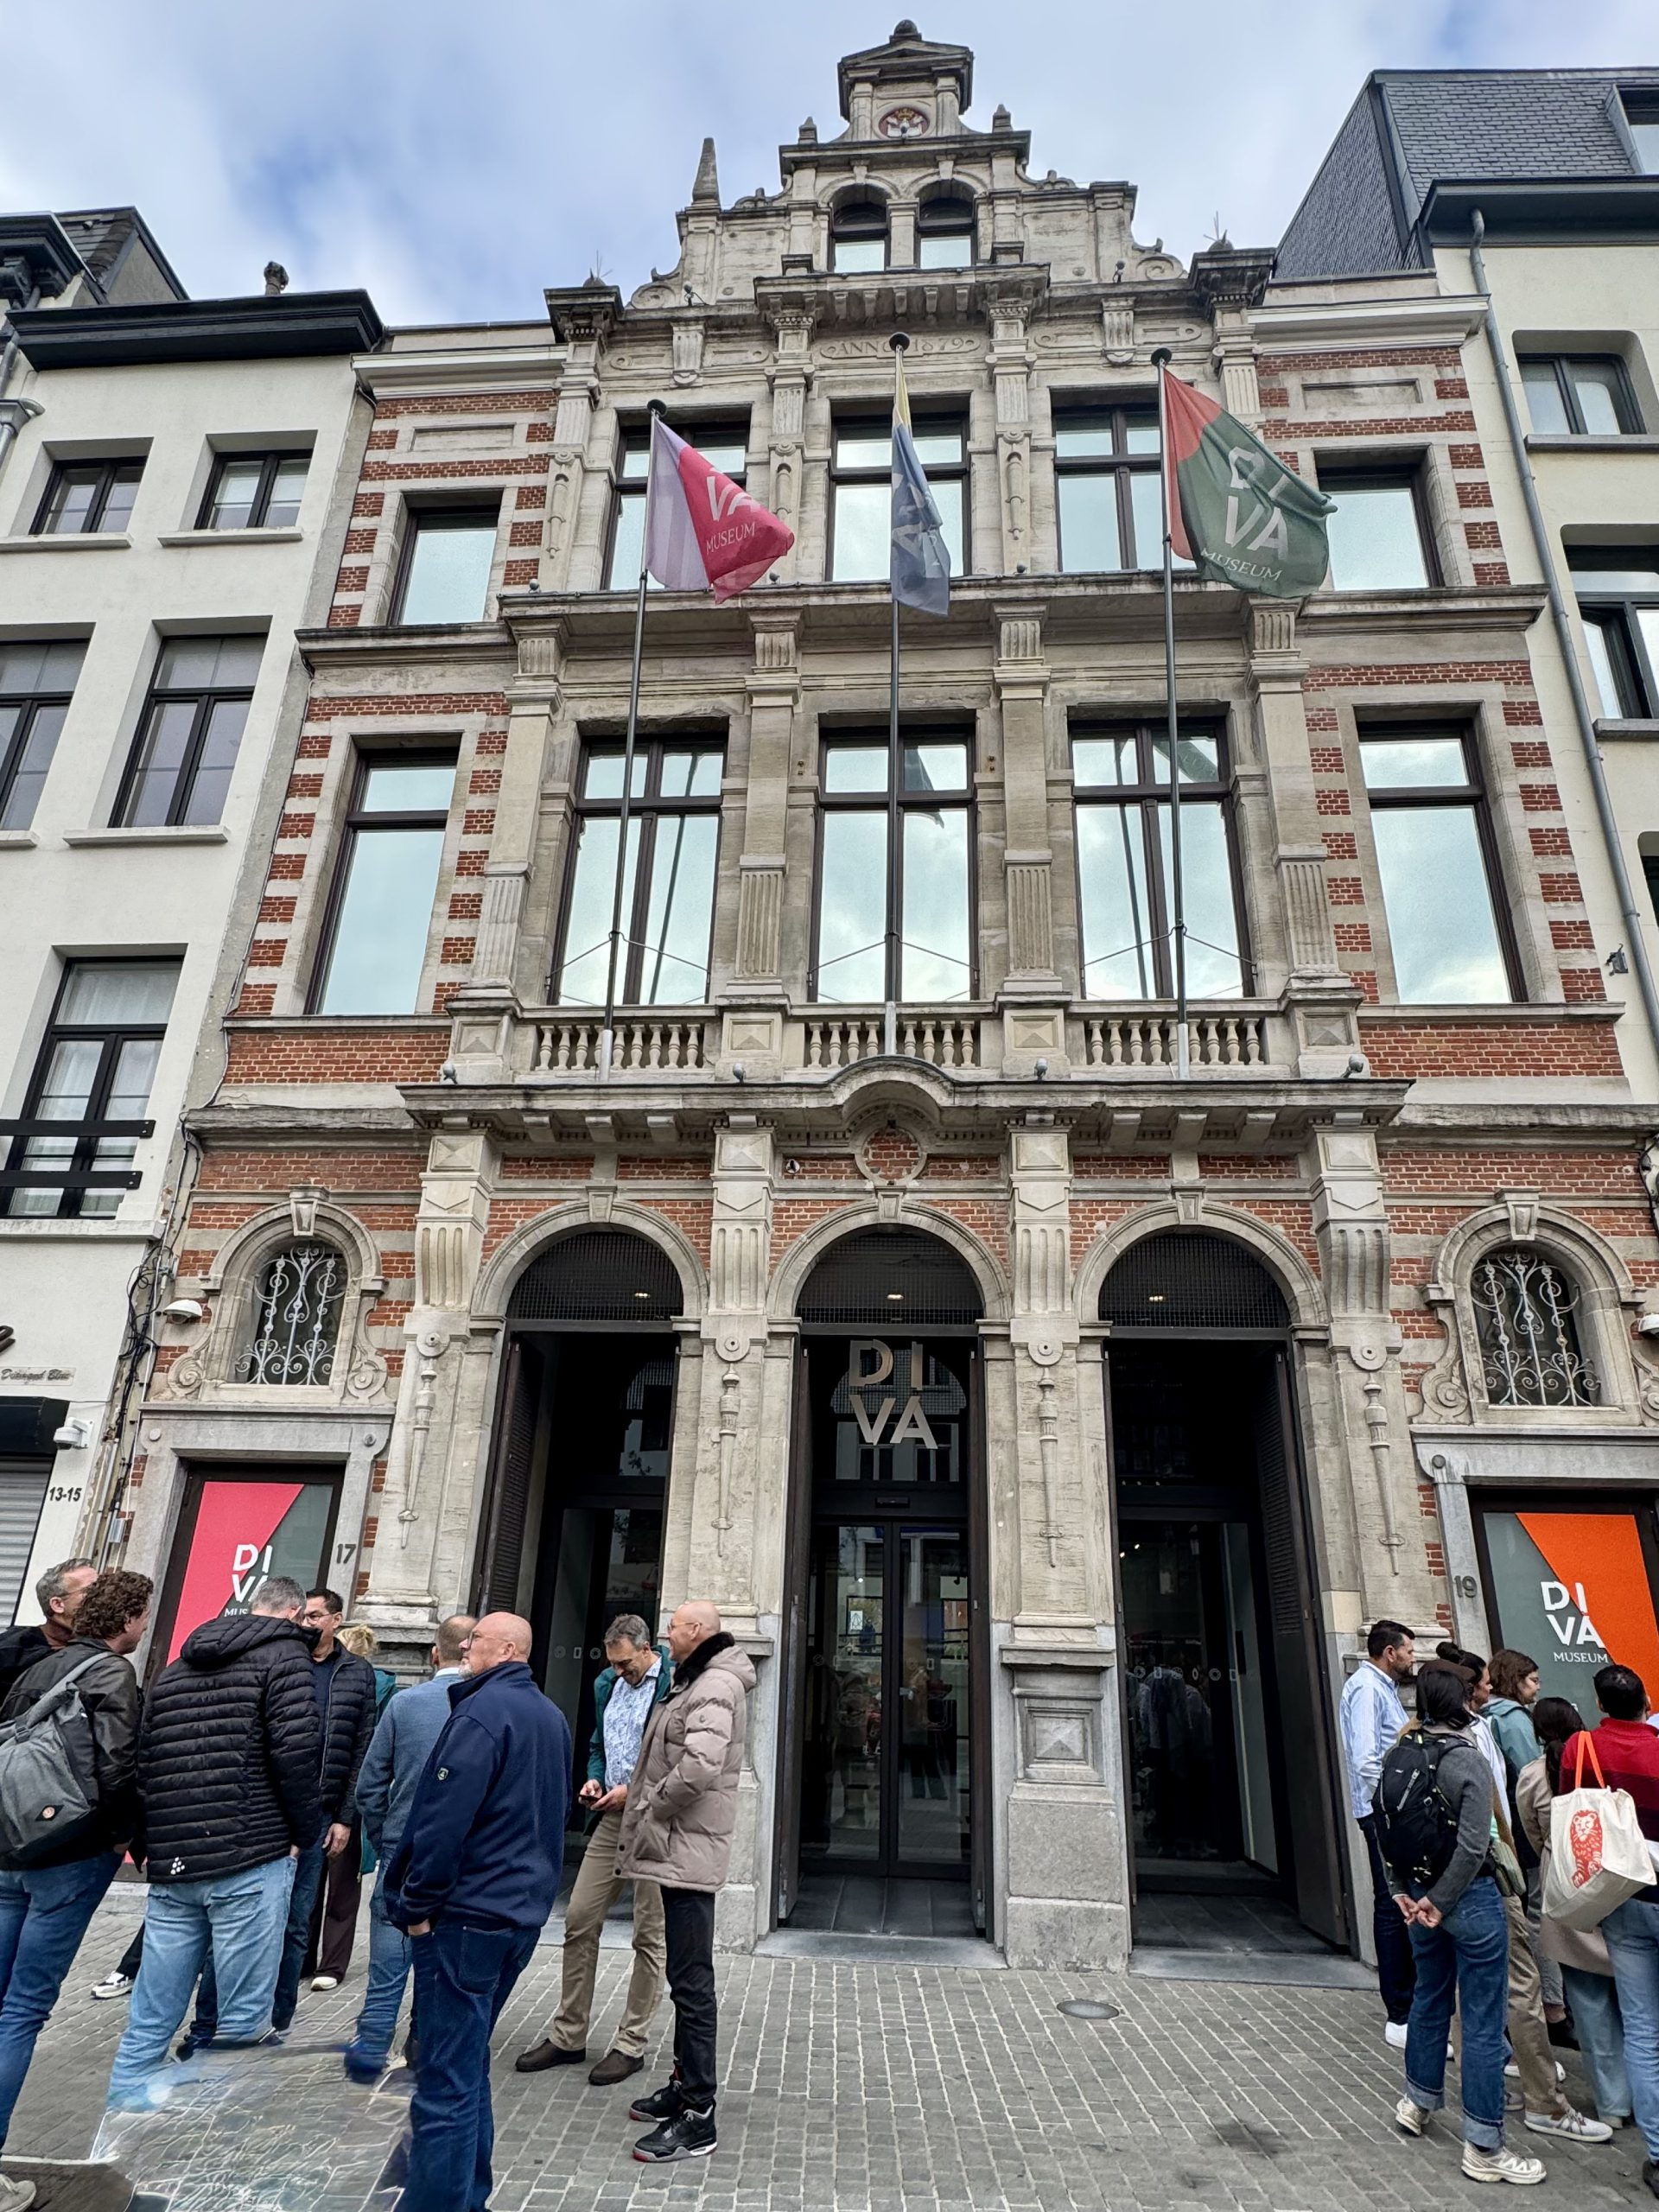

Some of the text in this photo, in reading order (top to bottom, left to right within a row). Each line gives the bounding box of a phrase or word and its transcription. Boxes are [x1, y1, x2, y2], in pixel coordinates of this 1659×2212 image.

[913, 337, 964, 353] 1879
[705, 522, 756, 556] MUSEUM
[1225, 495, 1288, 560] VA
[1201, 547, 1282, 582] MUSEUM
[849, 1338, 924, 1391] DI
[849, 1394, 938, 1450] VA
[48, 1486, 82, 1503] 13-15
[232, 1543, 273, 1573] DI
[336, 1543, 357, 1564] 17
[1453, 1575, 1478, 1599] 19
[1541, 1581, 1587, 1614] DI
[1546, 1614, 1605, 1649] VA
[1553, 1651, 1609, 1663] MUSEUM
